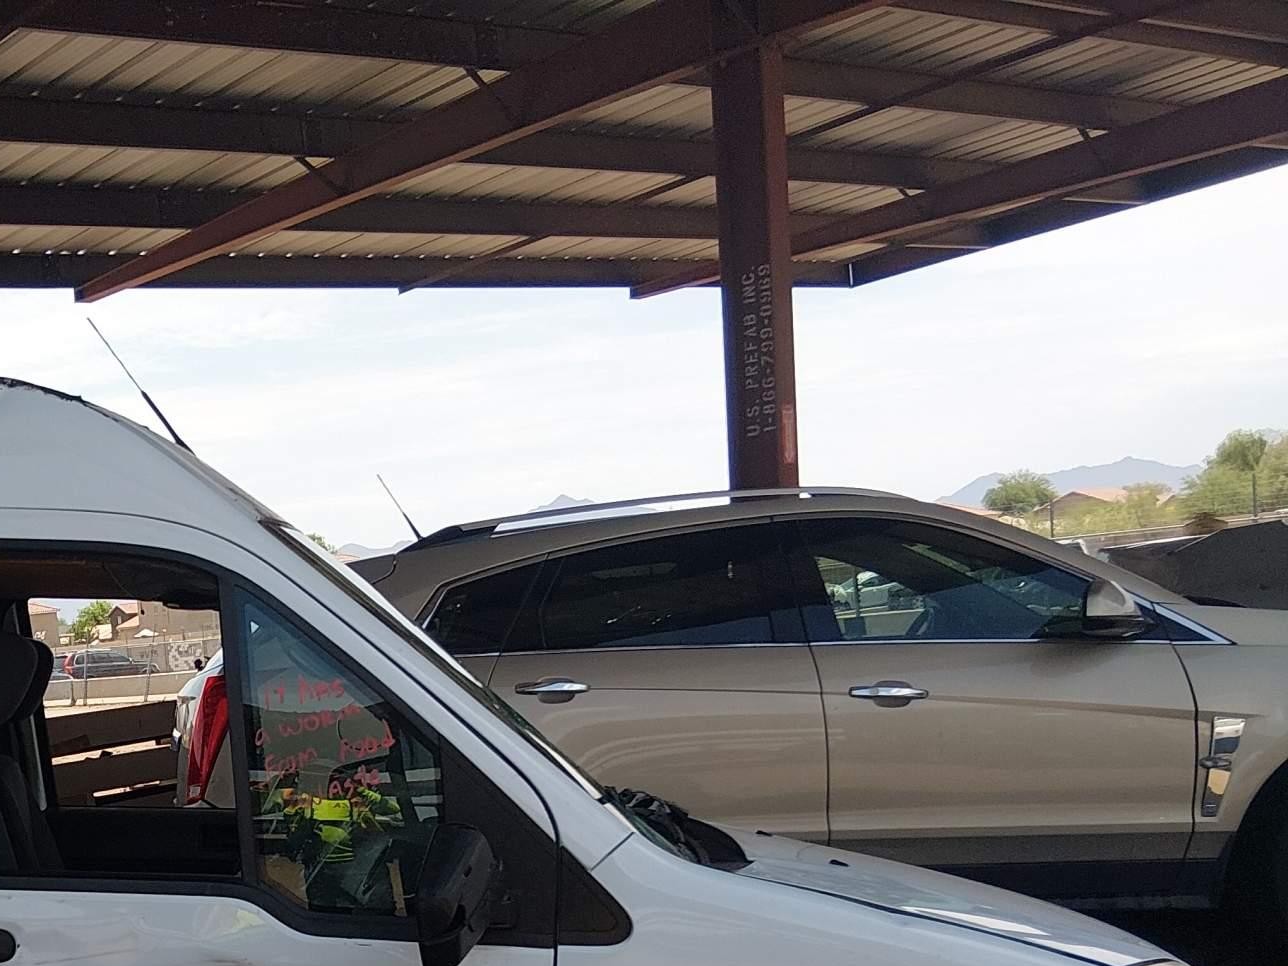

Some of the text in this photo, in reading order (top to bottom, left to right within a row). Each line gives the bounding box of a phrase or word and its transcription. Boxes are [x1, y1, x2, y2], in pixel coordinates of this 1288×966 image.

[741, 266, 761, 437] U.S. PREFAB INC.
